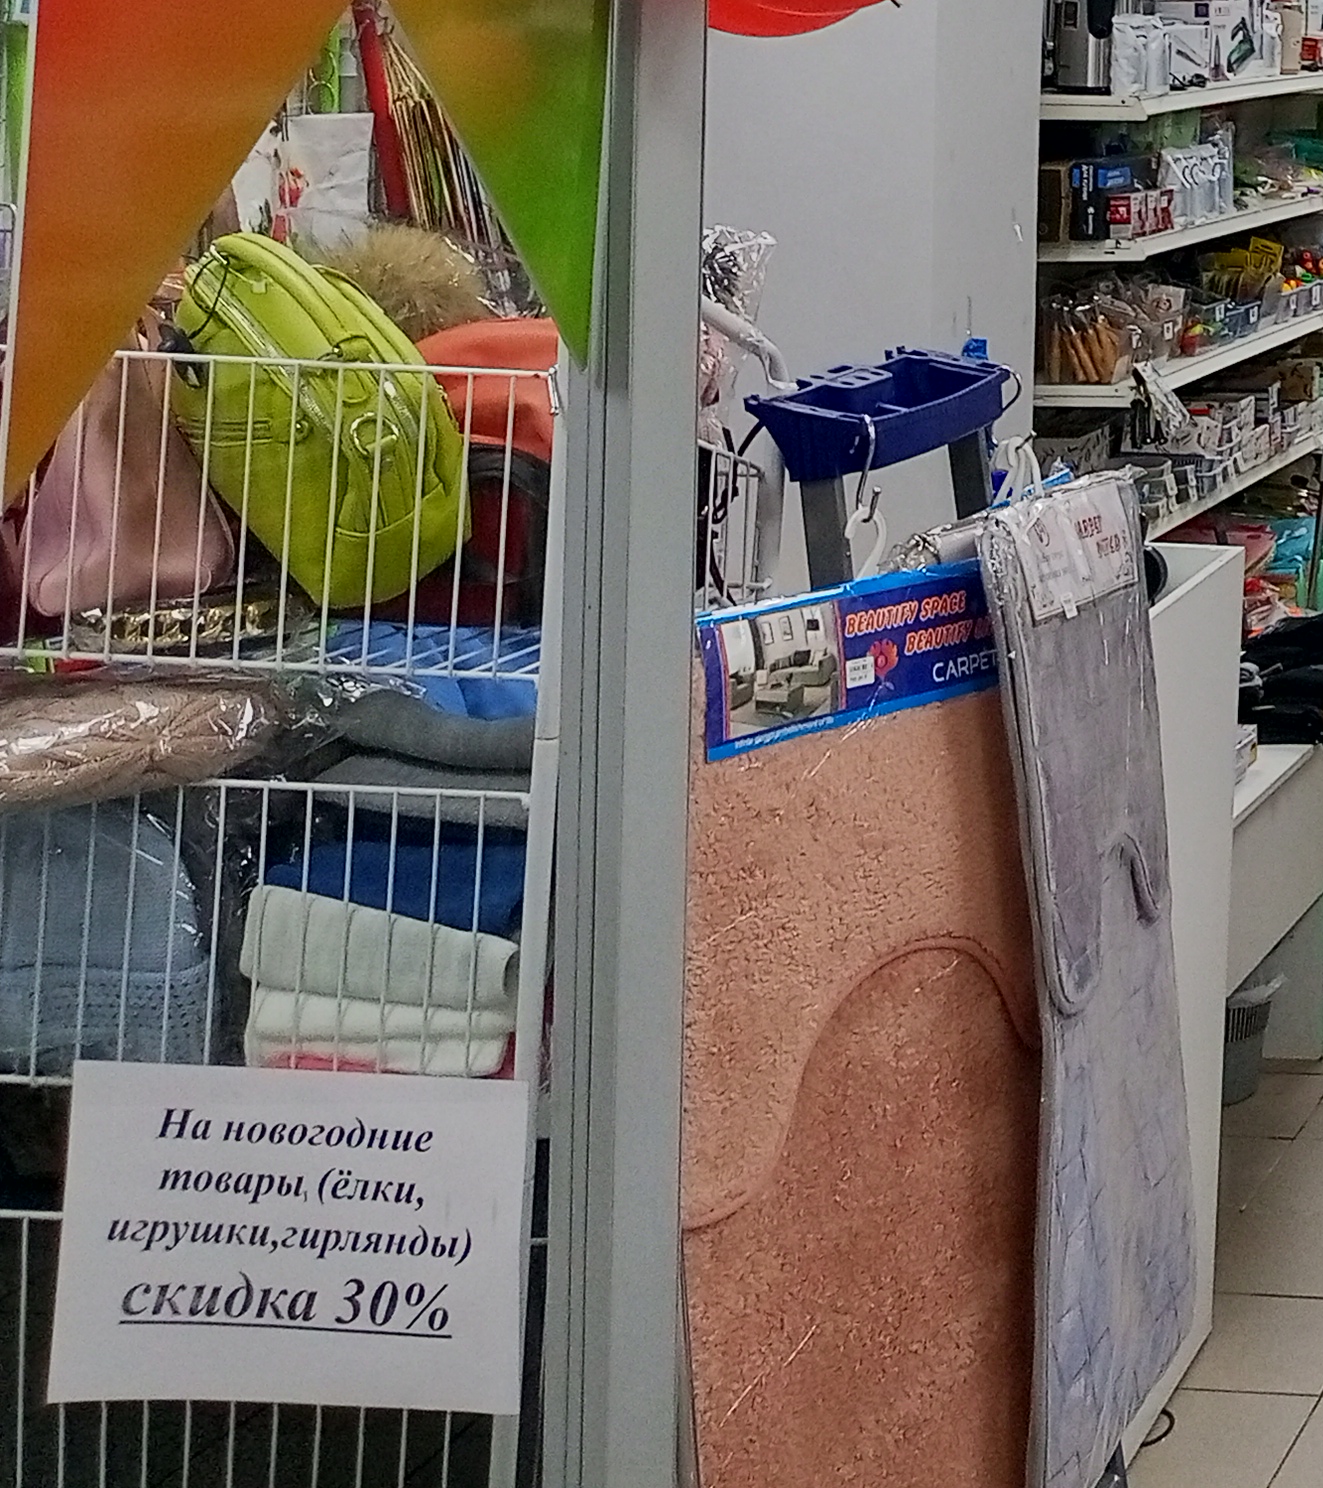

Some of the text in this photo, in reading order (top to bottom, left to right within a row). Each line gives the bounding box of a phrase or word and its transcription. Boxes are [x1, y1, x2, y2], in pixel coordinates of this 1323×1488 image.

[844, 589, 968, 638] BEAUTIFY SPACE
[903, 619, 973, 657] BEAUTIFY
[931, 649, 999, 683] CARPET
[156, 1107, 434, 1154] На новогодние
[317, 1167, 425, 1211] (ёлки,
[107, 1217, 473, 1266] игрушки,гирлянды)
[121, 1271, 451, 1333] скидка 30%
